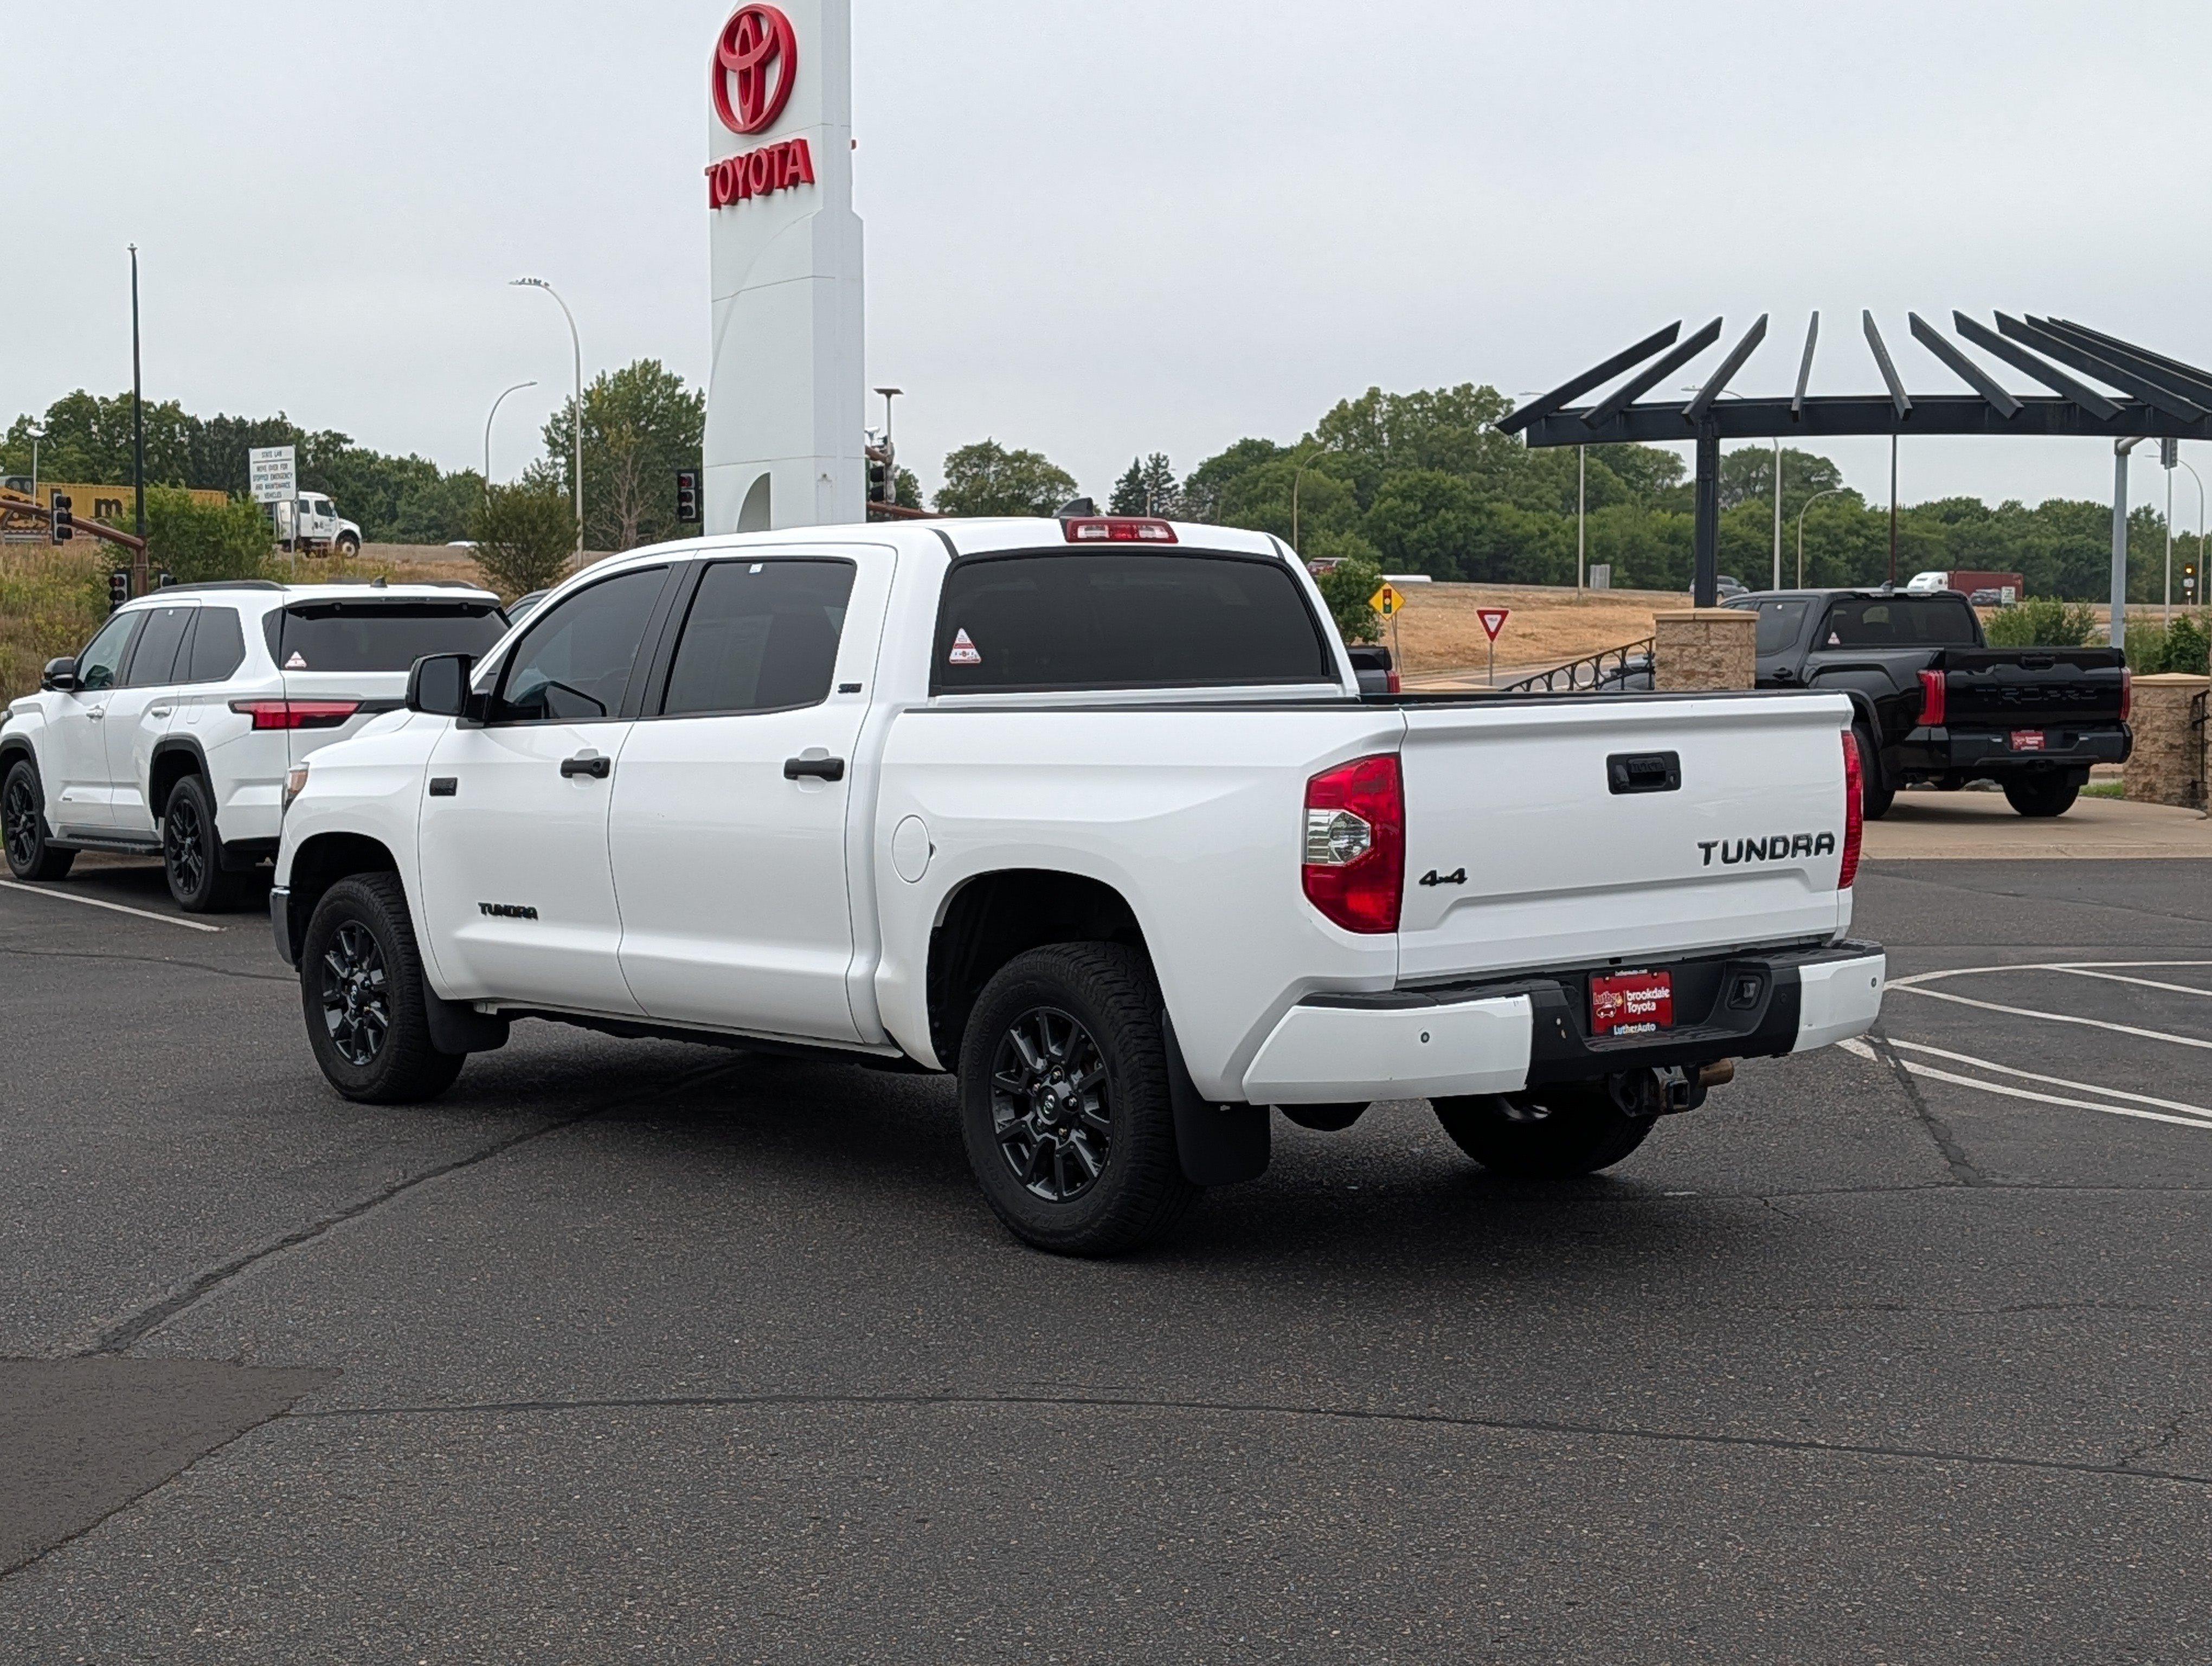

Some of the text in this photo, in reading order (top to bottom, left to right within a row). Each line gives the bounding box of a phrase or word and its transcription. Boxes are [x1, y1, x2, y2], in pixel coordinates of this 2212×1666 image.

[704, 138, 815, 210] TOYOTA
[1697, 831, 1835, 866] TUNDRA
[477, 901, 538, 921] TUNDRA
[1626, 986, 1670, 1002] brookdale
[1626, 1001, 1656, 1015] Toyota
[1613, 1022, 1656, 1035] LutherAuto
